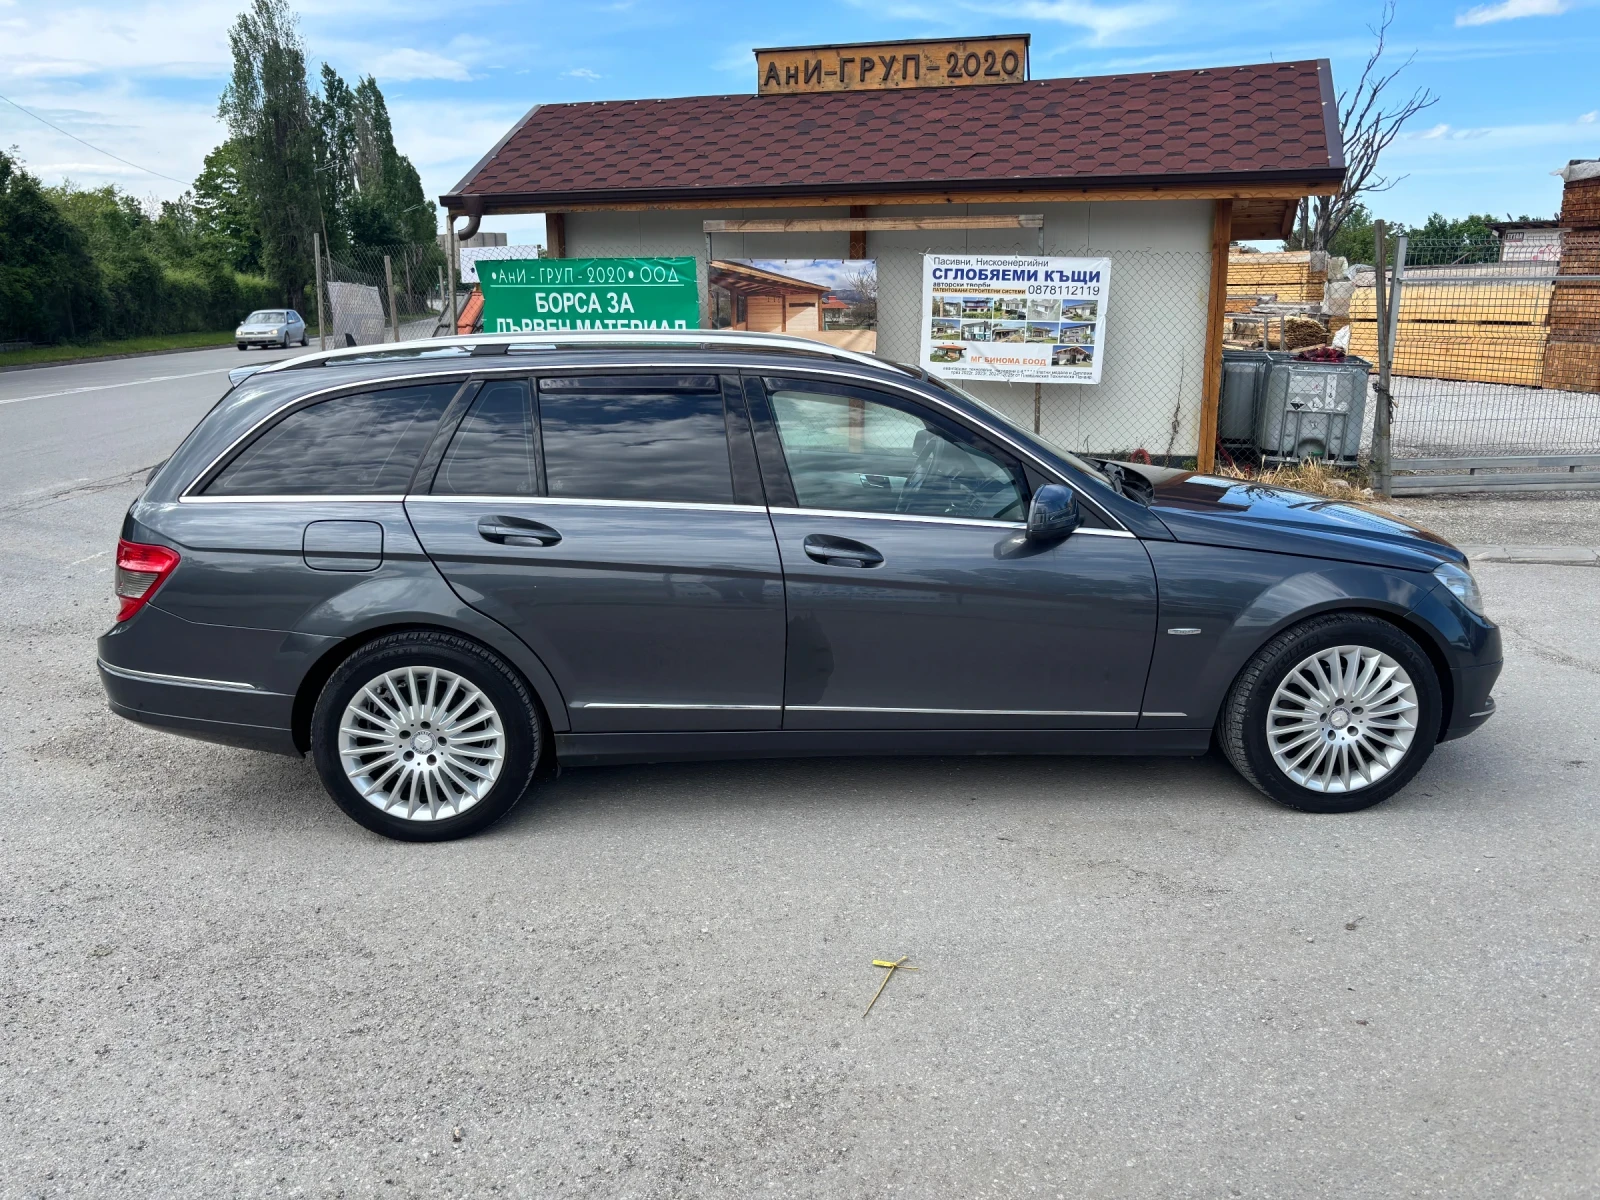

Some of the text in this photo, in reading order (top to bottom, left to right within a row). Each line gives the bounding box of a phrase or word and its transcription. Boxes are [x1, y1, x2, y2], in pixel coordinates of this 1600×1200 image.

[933, 257, 1049, 268] Пасивни, Нискоенергийни
[539, 267, 574, 284] ГРУП
[639, 266, 680, 284] ООД
[932, 268, 1101, 285] СГЛОБЯЕМИ КЪЩИ
[1028, 284, 1100, 296] 0878112119
[535, 292, 635, 314] БОРСА ЗА
[970, 355, 1047, 367] МГ БИНОМА ЕООД
